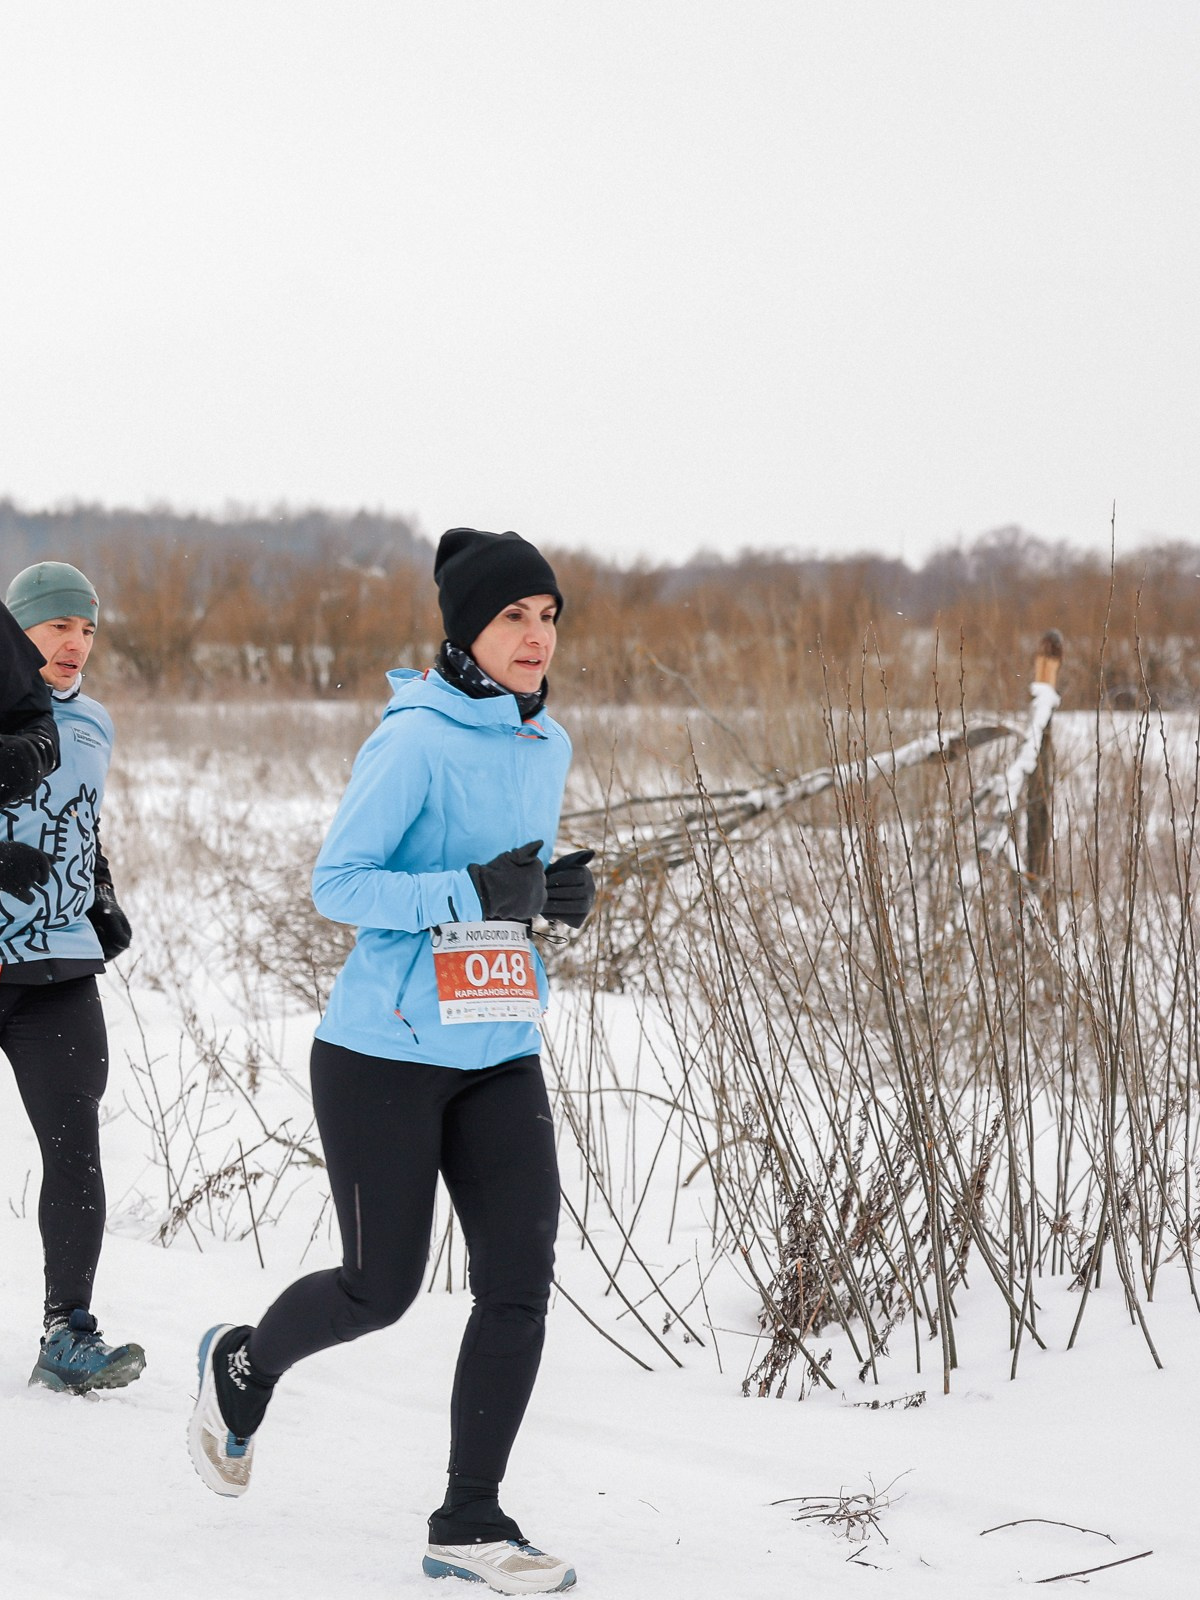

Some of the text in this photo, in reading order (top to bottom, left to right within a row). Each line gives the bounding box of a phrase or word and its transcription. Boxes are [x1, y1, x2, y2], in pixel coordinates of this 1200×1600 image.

[466, 930, 509, 941] NOVGOROD
[464, 952, 528, 988] 048
[455, 989, 509, 998] КАРАБАНОВА
